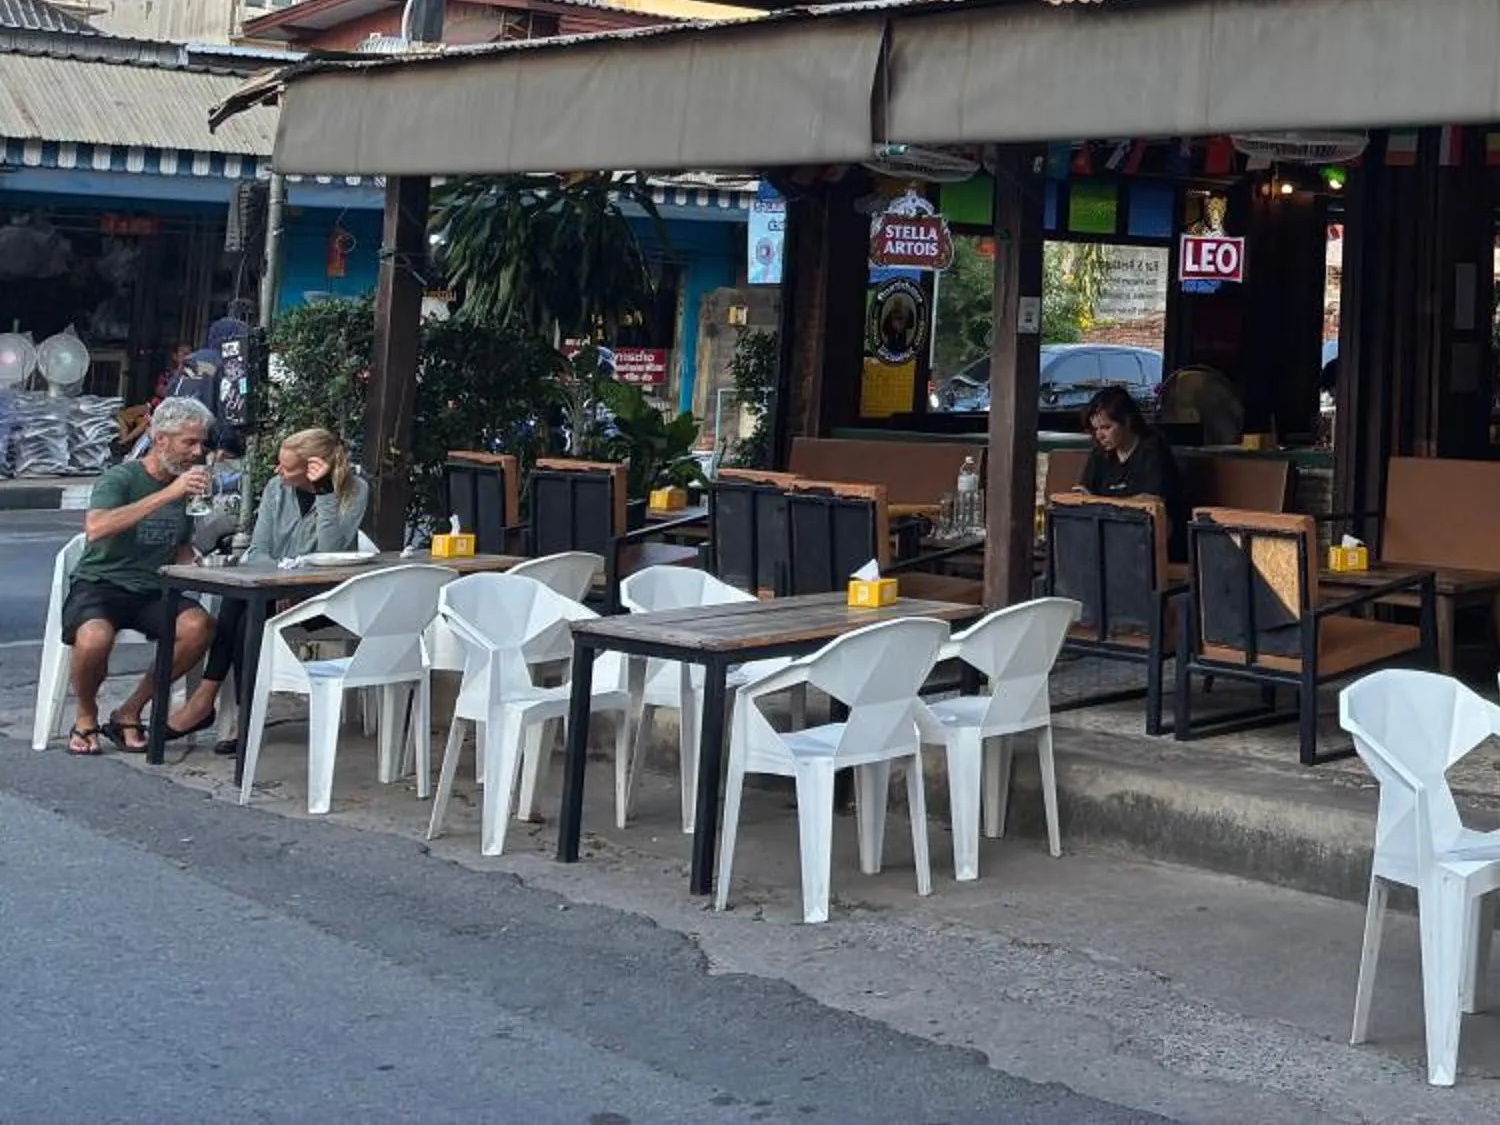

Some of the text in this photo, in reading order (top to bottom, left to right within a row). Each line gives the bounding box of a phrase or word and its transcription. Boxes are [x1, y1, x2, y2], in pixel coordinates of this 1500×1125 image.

[885, 224, 938, 241] STELLA
[883, 240, 939, 257] ARTOIS
[1185, 240, 1238, 274] LEO
